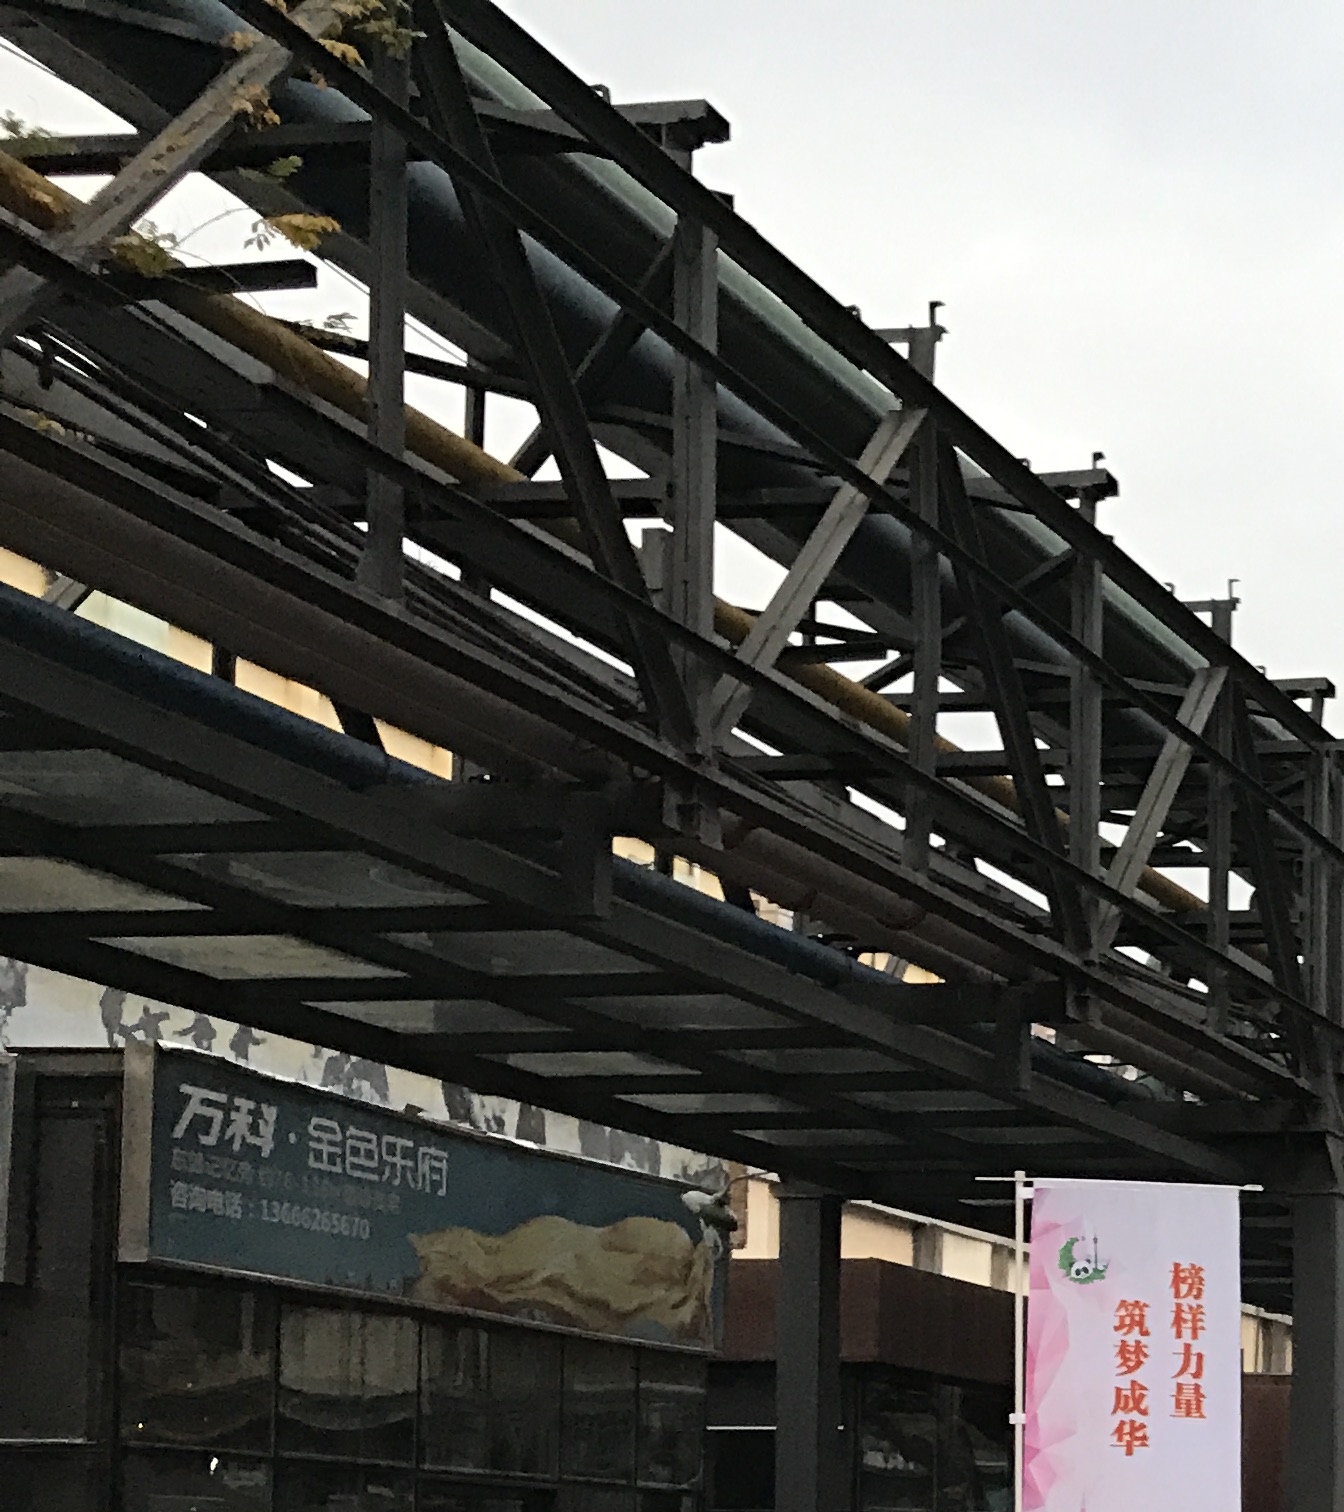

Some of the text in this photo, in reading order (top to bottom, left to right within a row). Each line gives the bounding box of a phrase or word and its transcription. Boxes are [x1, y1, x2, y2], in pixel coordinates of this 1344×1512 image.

[1110, 1299, 1151, 1457] 筑梦成华
[1168, 1262, 1207, 1420] 榜样力量
